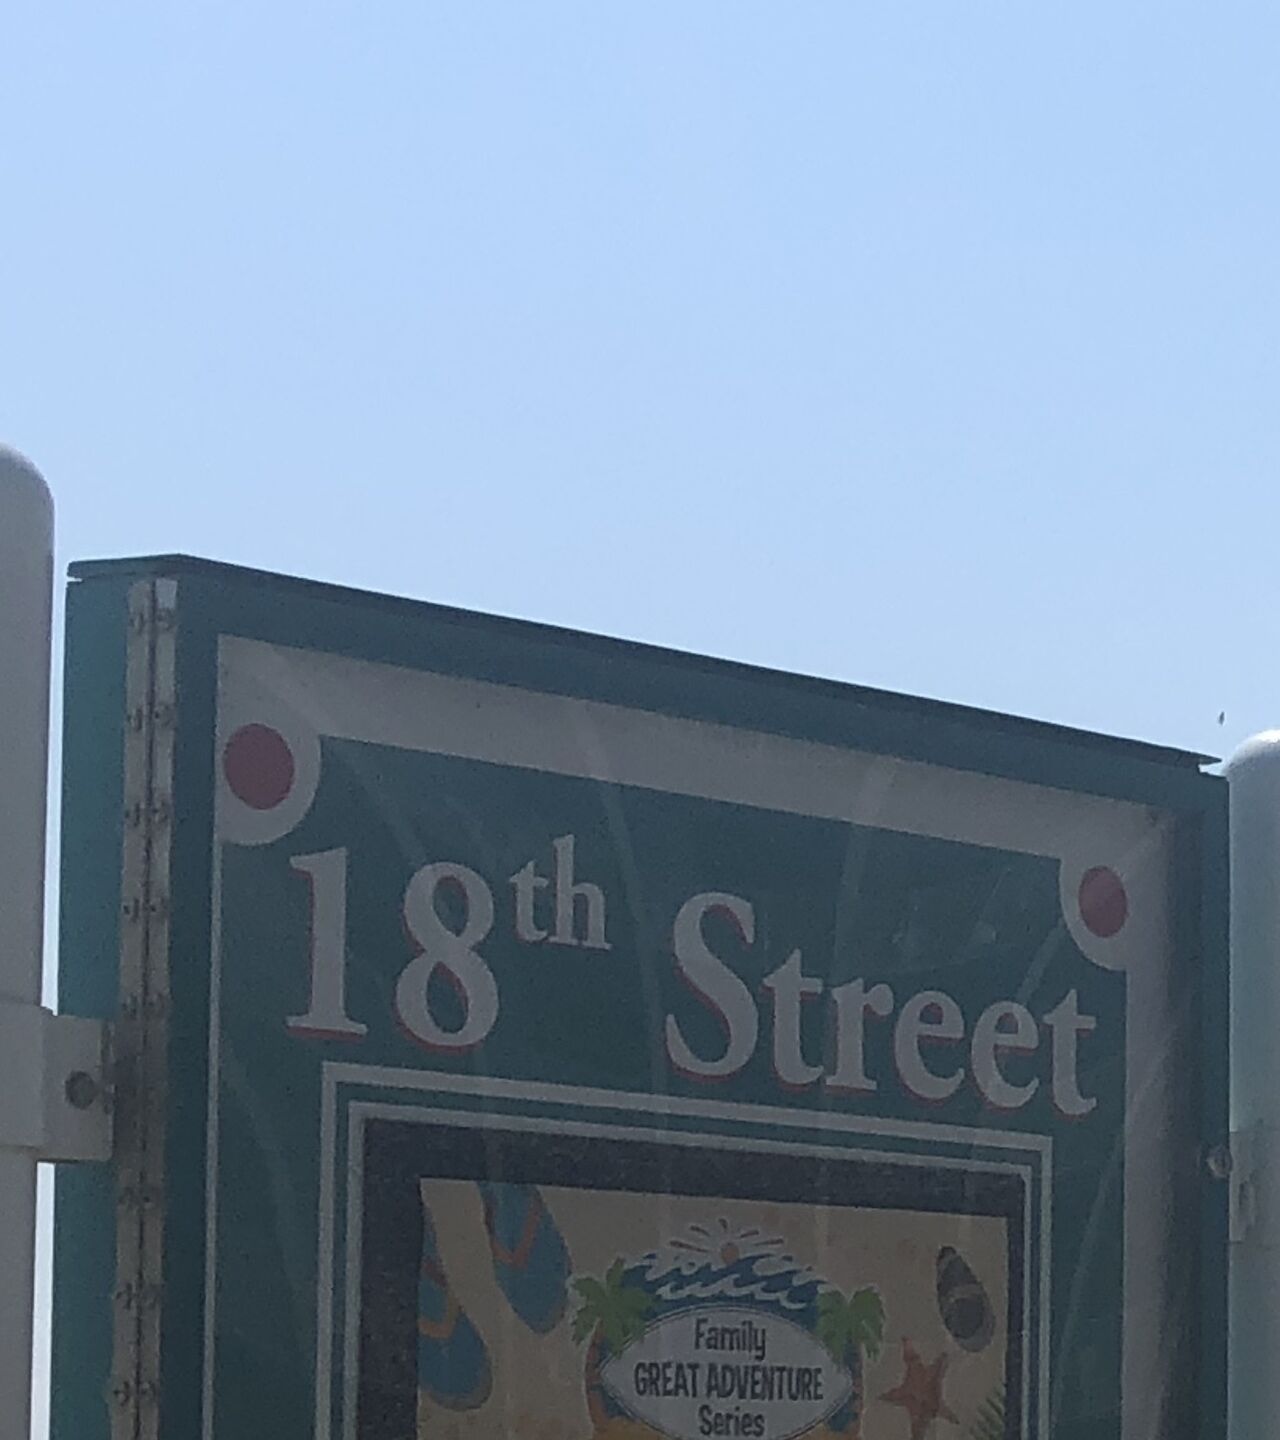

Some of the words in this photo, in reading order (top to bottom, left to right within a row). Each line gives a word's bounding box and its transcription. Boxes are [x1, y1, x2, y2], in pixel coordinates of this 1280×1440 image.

[284, 834, 613, 1052] 18th
[664, 892, 1097, 1118] Street
[694, 1318, 767, 1362] Family
[634, 1361, 700, 1399] GREAT
[706, 1364, 824, 1402] ADVENTURE
[698, 1403, 765, 1438] Series
